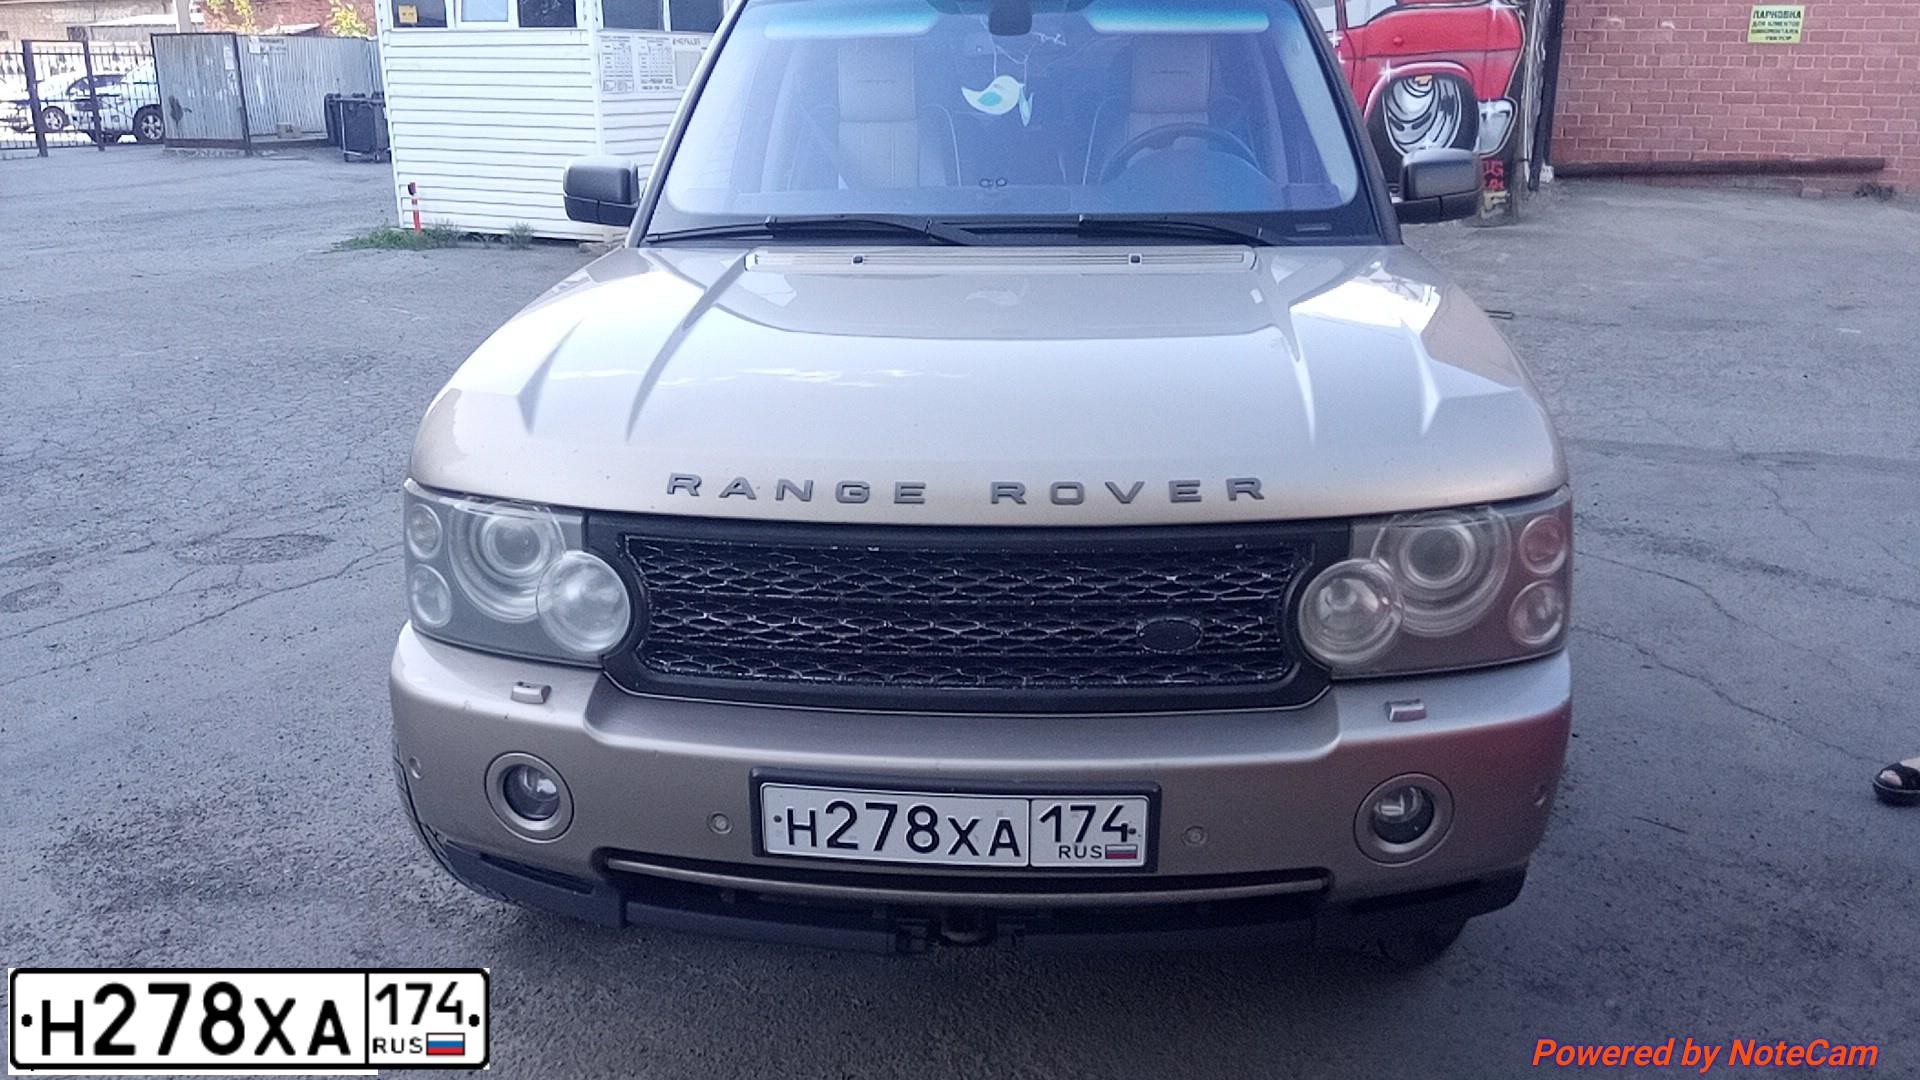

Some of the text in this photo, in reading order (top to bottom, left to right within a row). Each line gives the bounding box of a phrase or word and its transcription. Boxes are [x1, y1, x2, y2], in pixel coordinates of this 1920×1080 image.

[1753, 10, 1801, 19] ПАРКОВКА
[667, 473, 1265, 505] RANGE ROVER
[1039, 805, 1129, 843] 174
[1058, 844, 1103, 860] RUS
